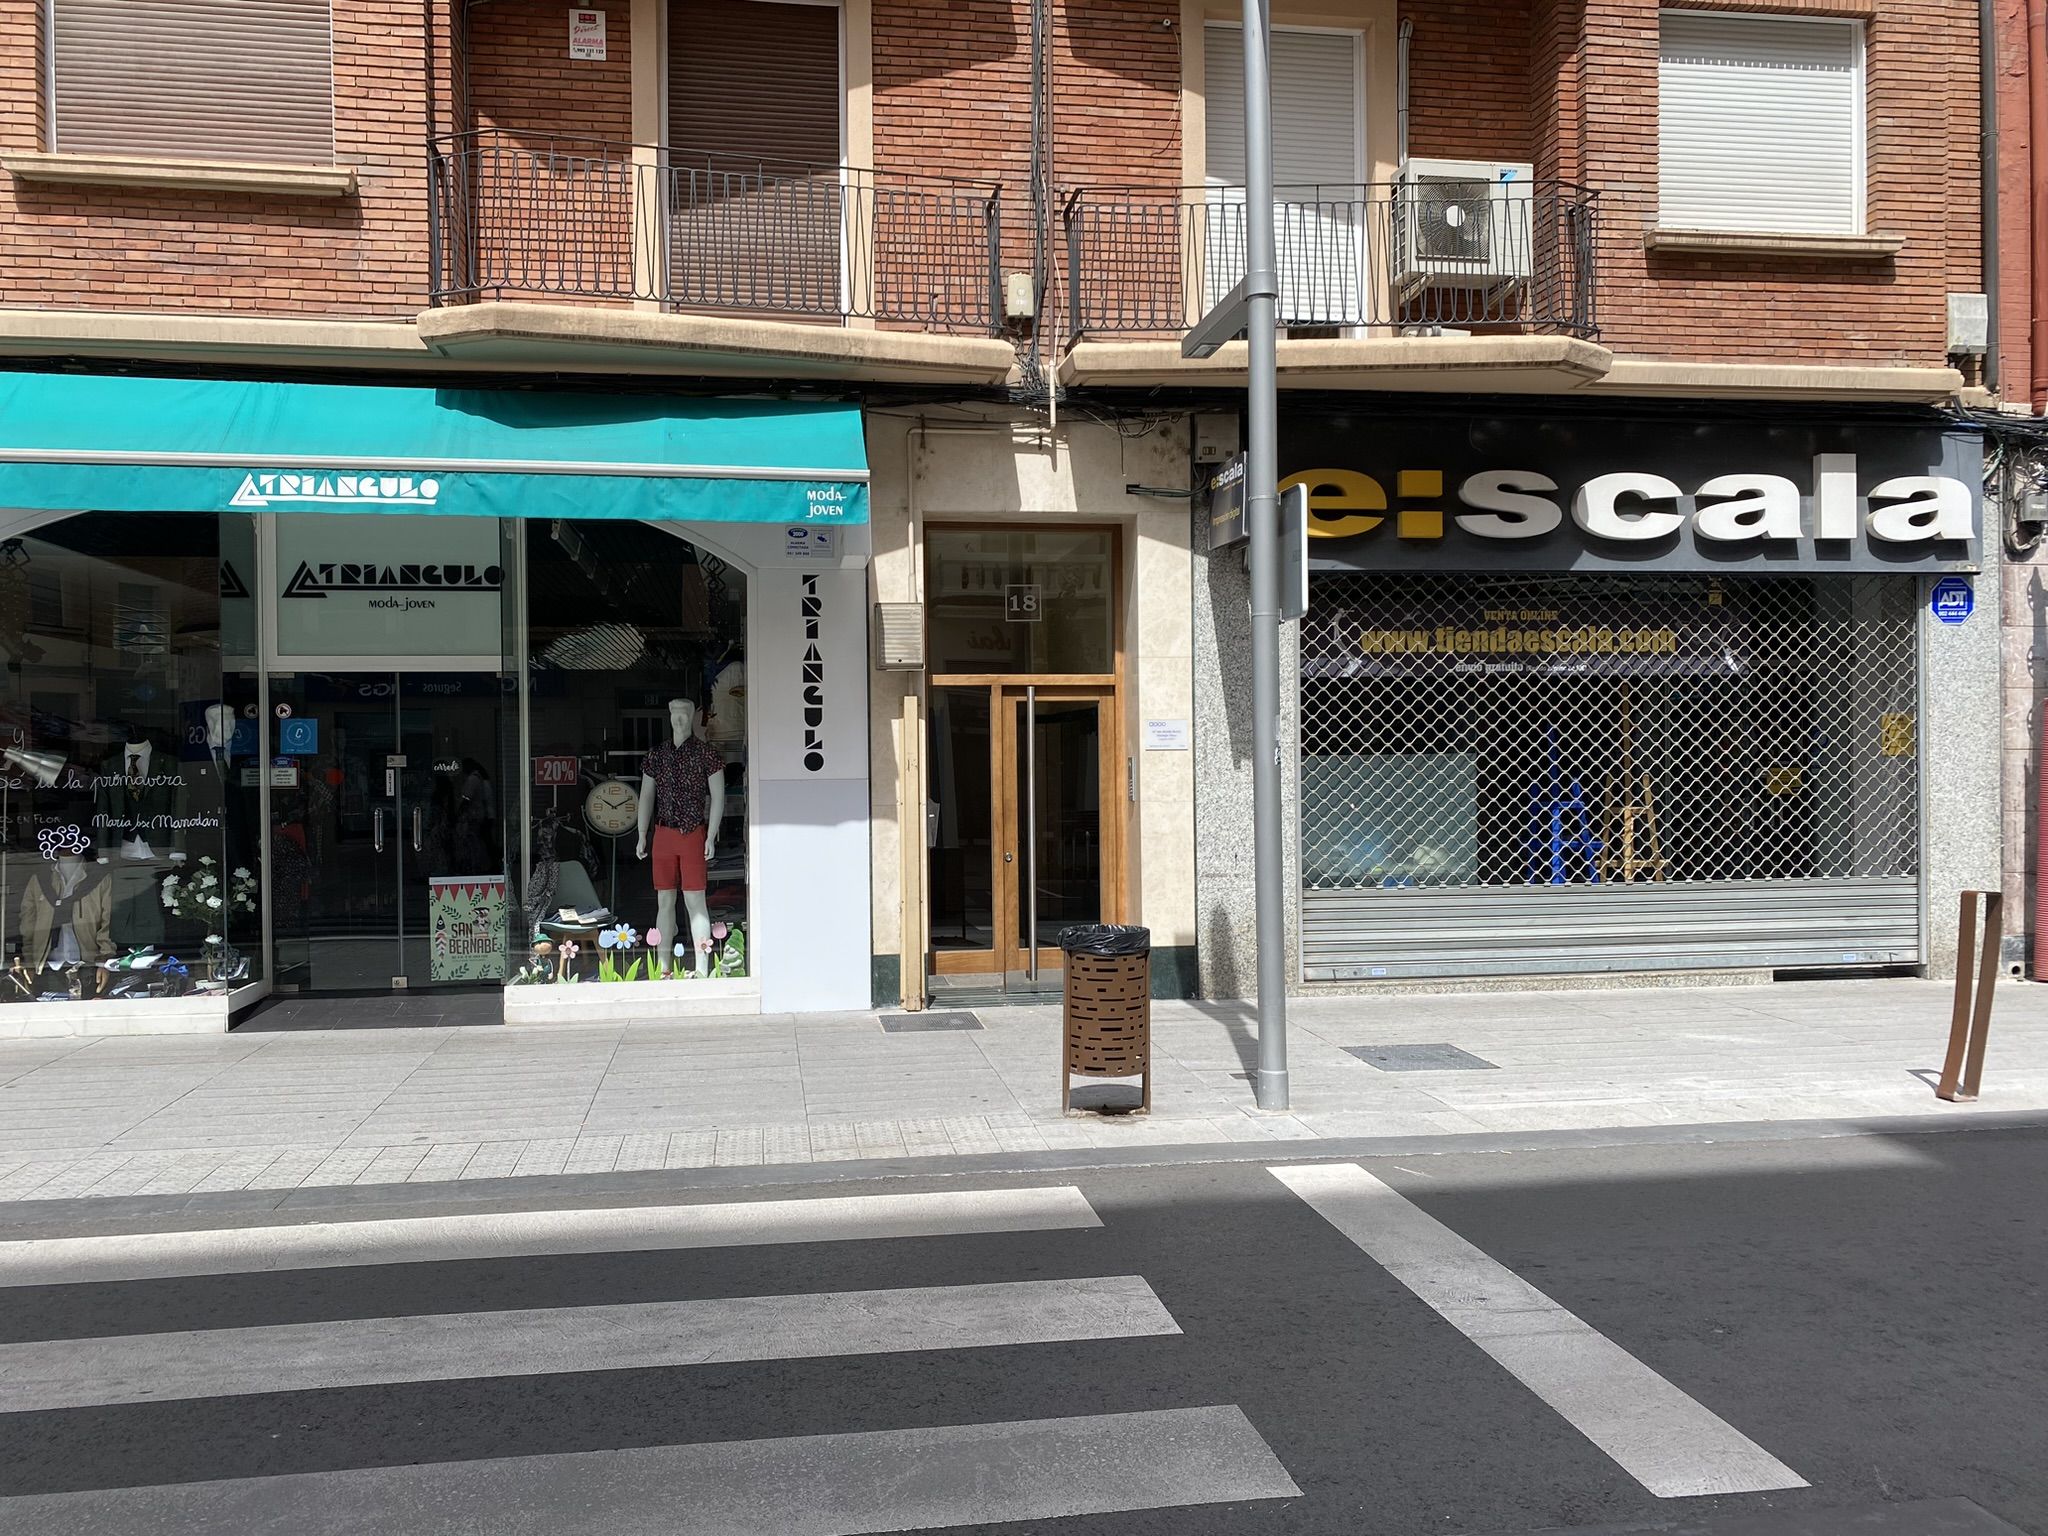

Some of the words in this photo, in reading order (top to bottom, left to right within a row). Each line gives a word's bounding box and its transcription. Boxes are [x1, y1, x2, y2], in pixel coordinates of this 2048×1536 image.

[573, 37, 604, 46] ALARMA
[1210, 462, 1243, 490] e:scala
[1277, 453, 1976, 542] e:scala
[1009, 594, 1037, 612] 18
[1938, 591, 1967, 606] ADT
[1360, 625, 1677, 653] www.tiendaescala.com
[538, 760, 574, 781] -20%
[62, 768, 85, 790] la
[89, 771, 188, 804] primavera
[593, 803, 603, 812] 9
[625, 803, 635, 812] 3
[608, 819, 619, 828] 6
[451, 921, 473, 939] SAN
[448, 933, 498, 955] BERNABÉ
